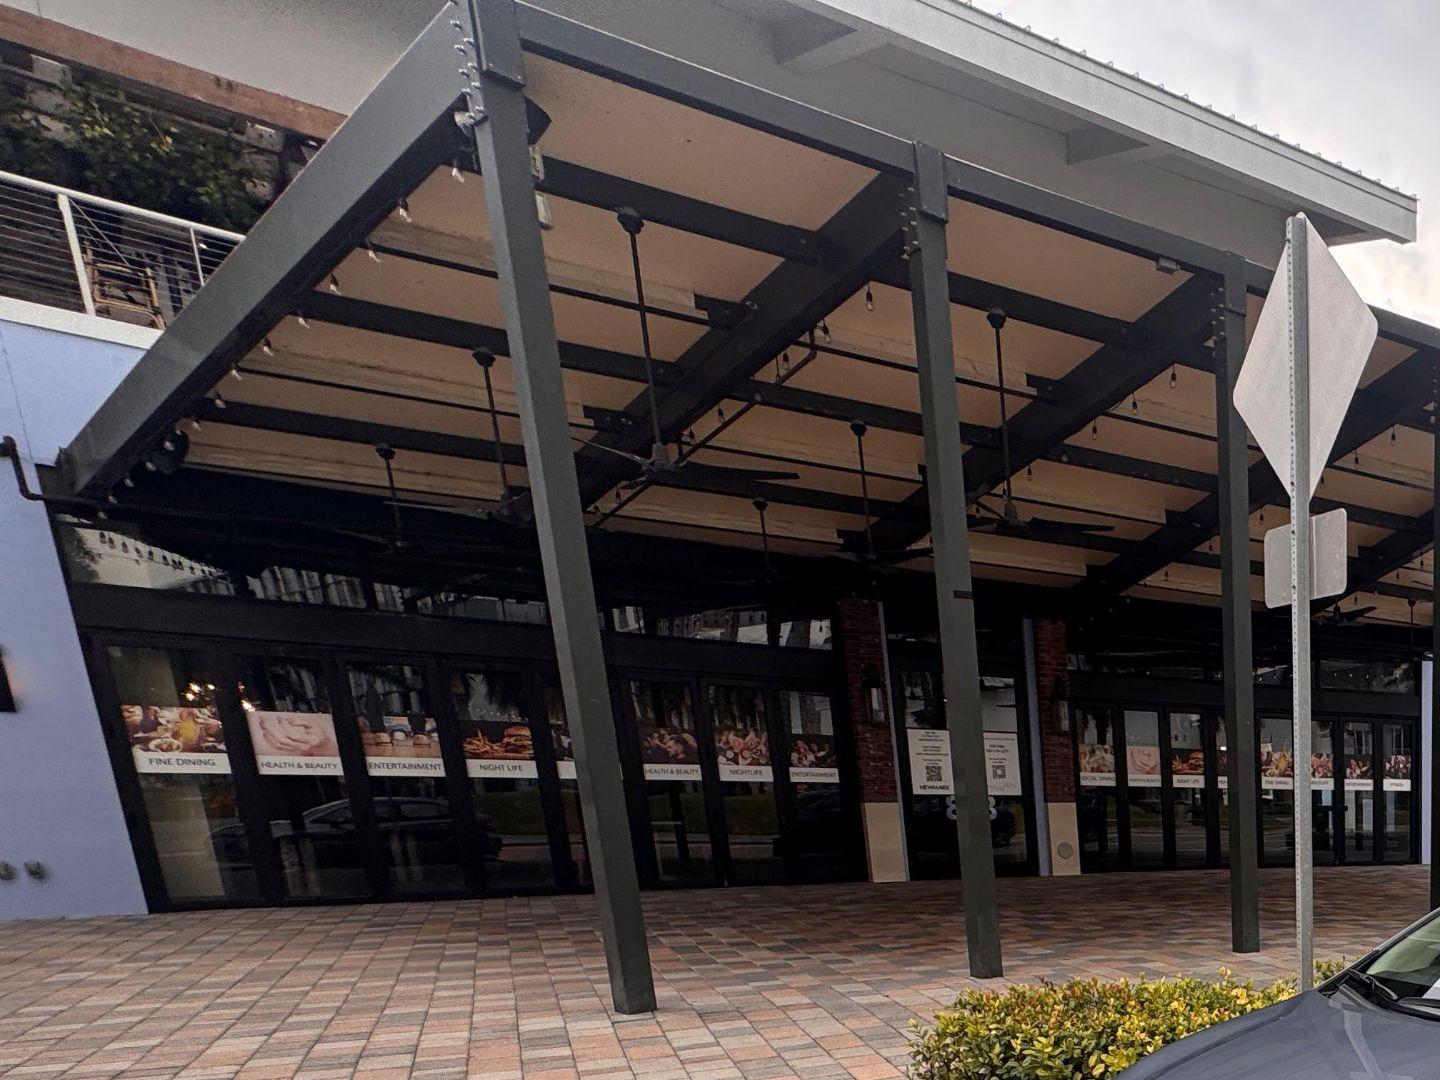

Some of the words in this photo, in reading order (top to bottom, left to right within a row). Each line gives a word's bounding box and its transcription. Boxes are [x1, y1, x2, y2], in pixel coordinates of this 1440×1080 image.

[148, 757, 173, 767] FINE
[176, 758, 216, 767] DINING
[261, 761, 295, 769] HEALTH
[304, 762, 338, 770] BEAUTY
[368, 762, 442, 771] ENTERTAINMENT
[479, 764, 505, 772] NIGHT
[507, 764, 523, 772] LIFE
[729, 769, 763, 777] NIGHTLIFE
